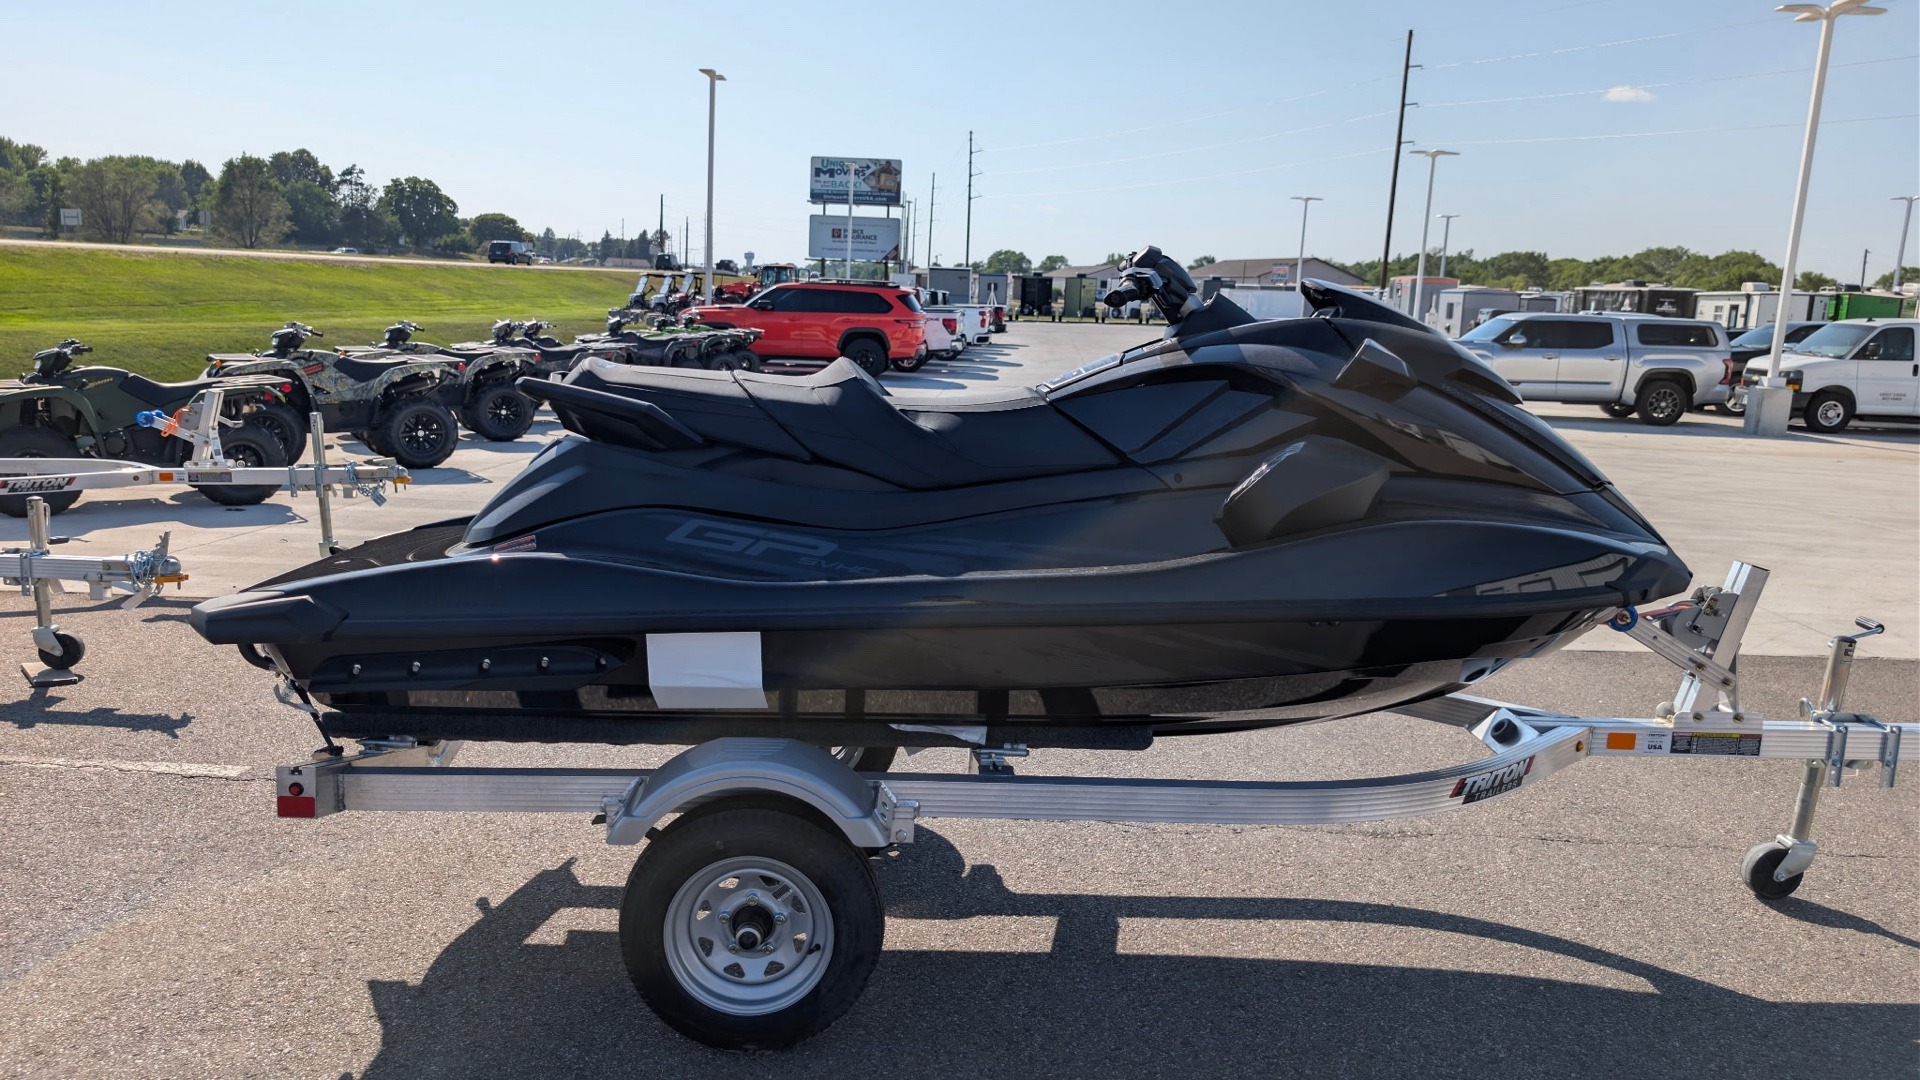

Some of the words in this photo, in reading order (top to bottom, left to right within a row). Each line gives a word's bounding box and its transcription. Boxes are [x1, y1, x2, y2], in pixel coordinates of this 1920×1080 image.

[6, 477, 69, 489] TRITON
[665, 518, 839, 557] GP
[1461, 757, 1530, 796] TRITON
[1475, 780, 1518, 801] TRAILERS
